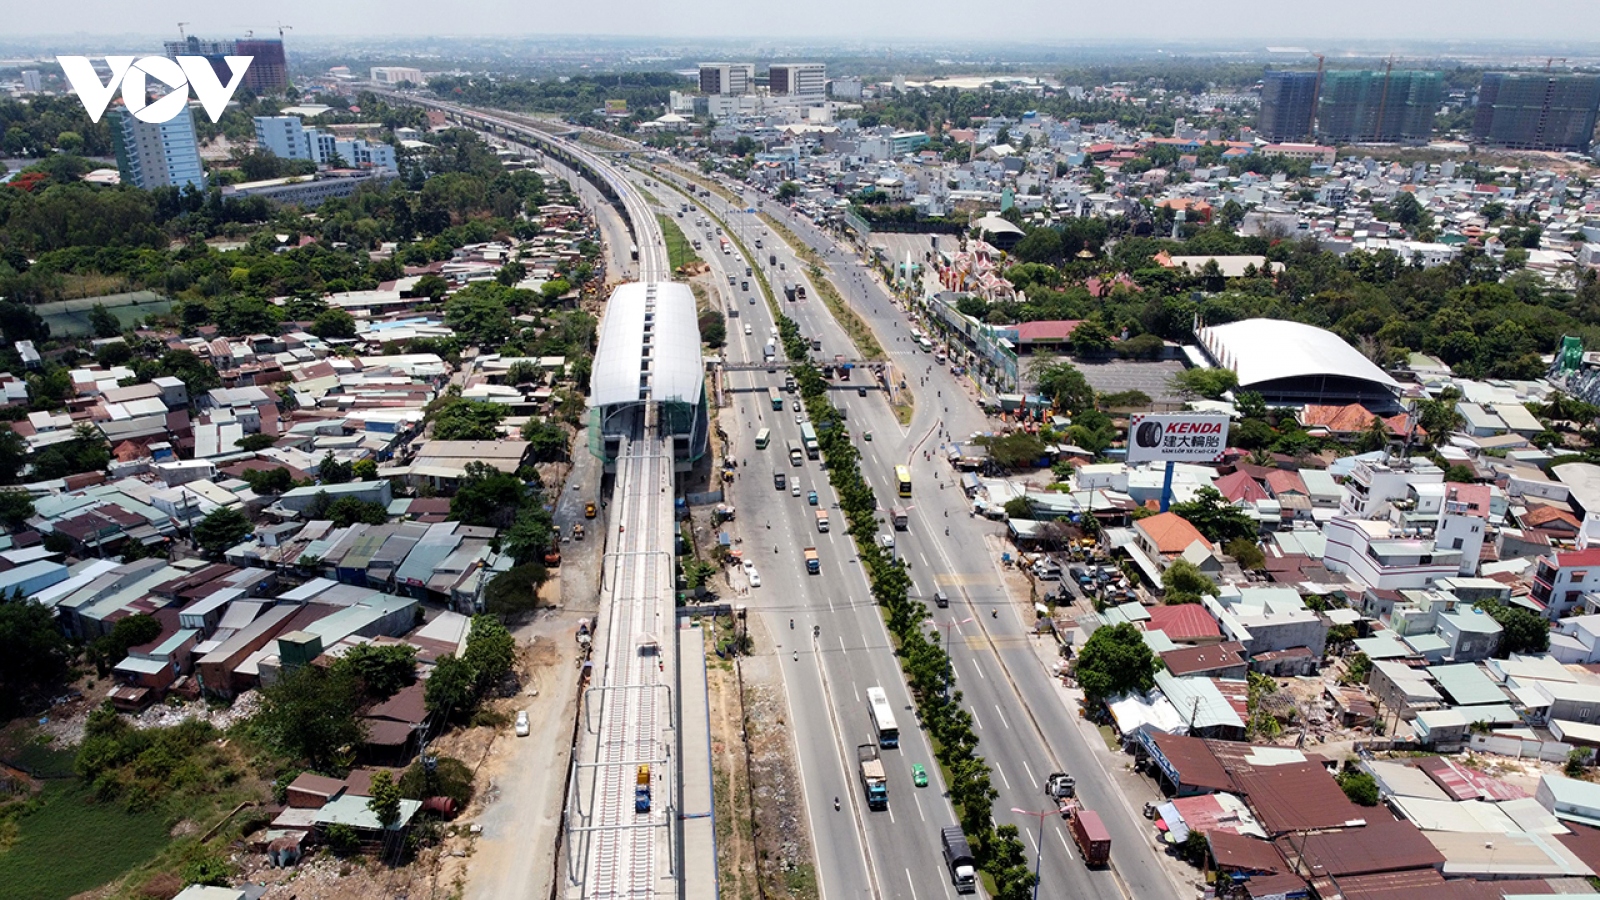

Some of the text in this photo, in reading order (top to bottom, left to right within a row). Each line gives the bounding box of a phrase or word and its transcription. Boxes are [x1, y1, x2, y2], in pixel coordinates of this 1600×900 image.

[1165, 422, 1222, 433] KENDA
[1162, 435, 1220, 448] 建大輪胎
